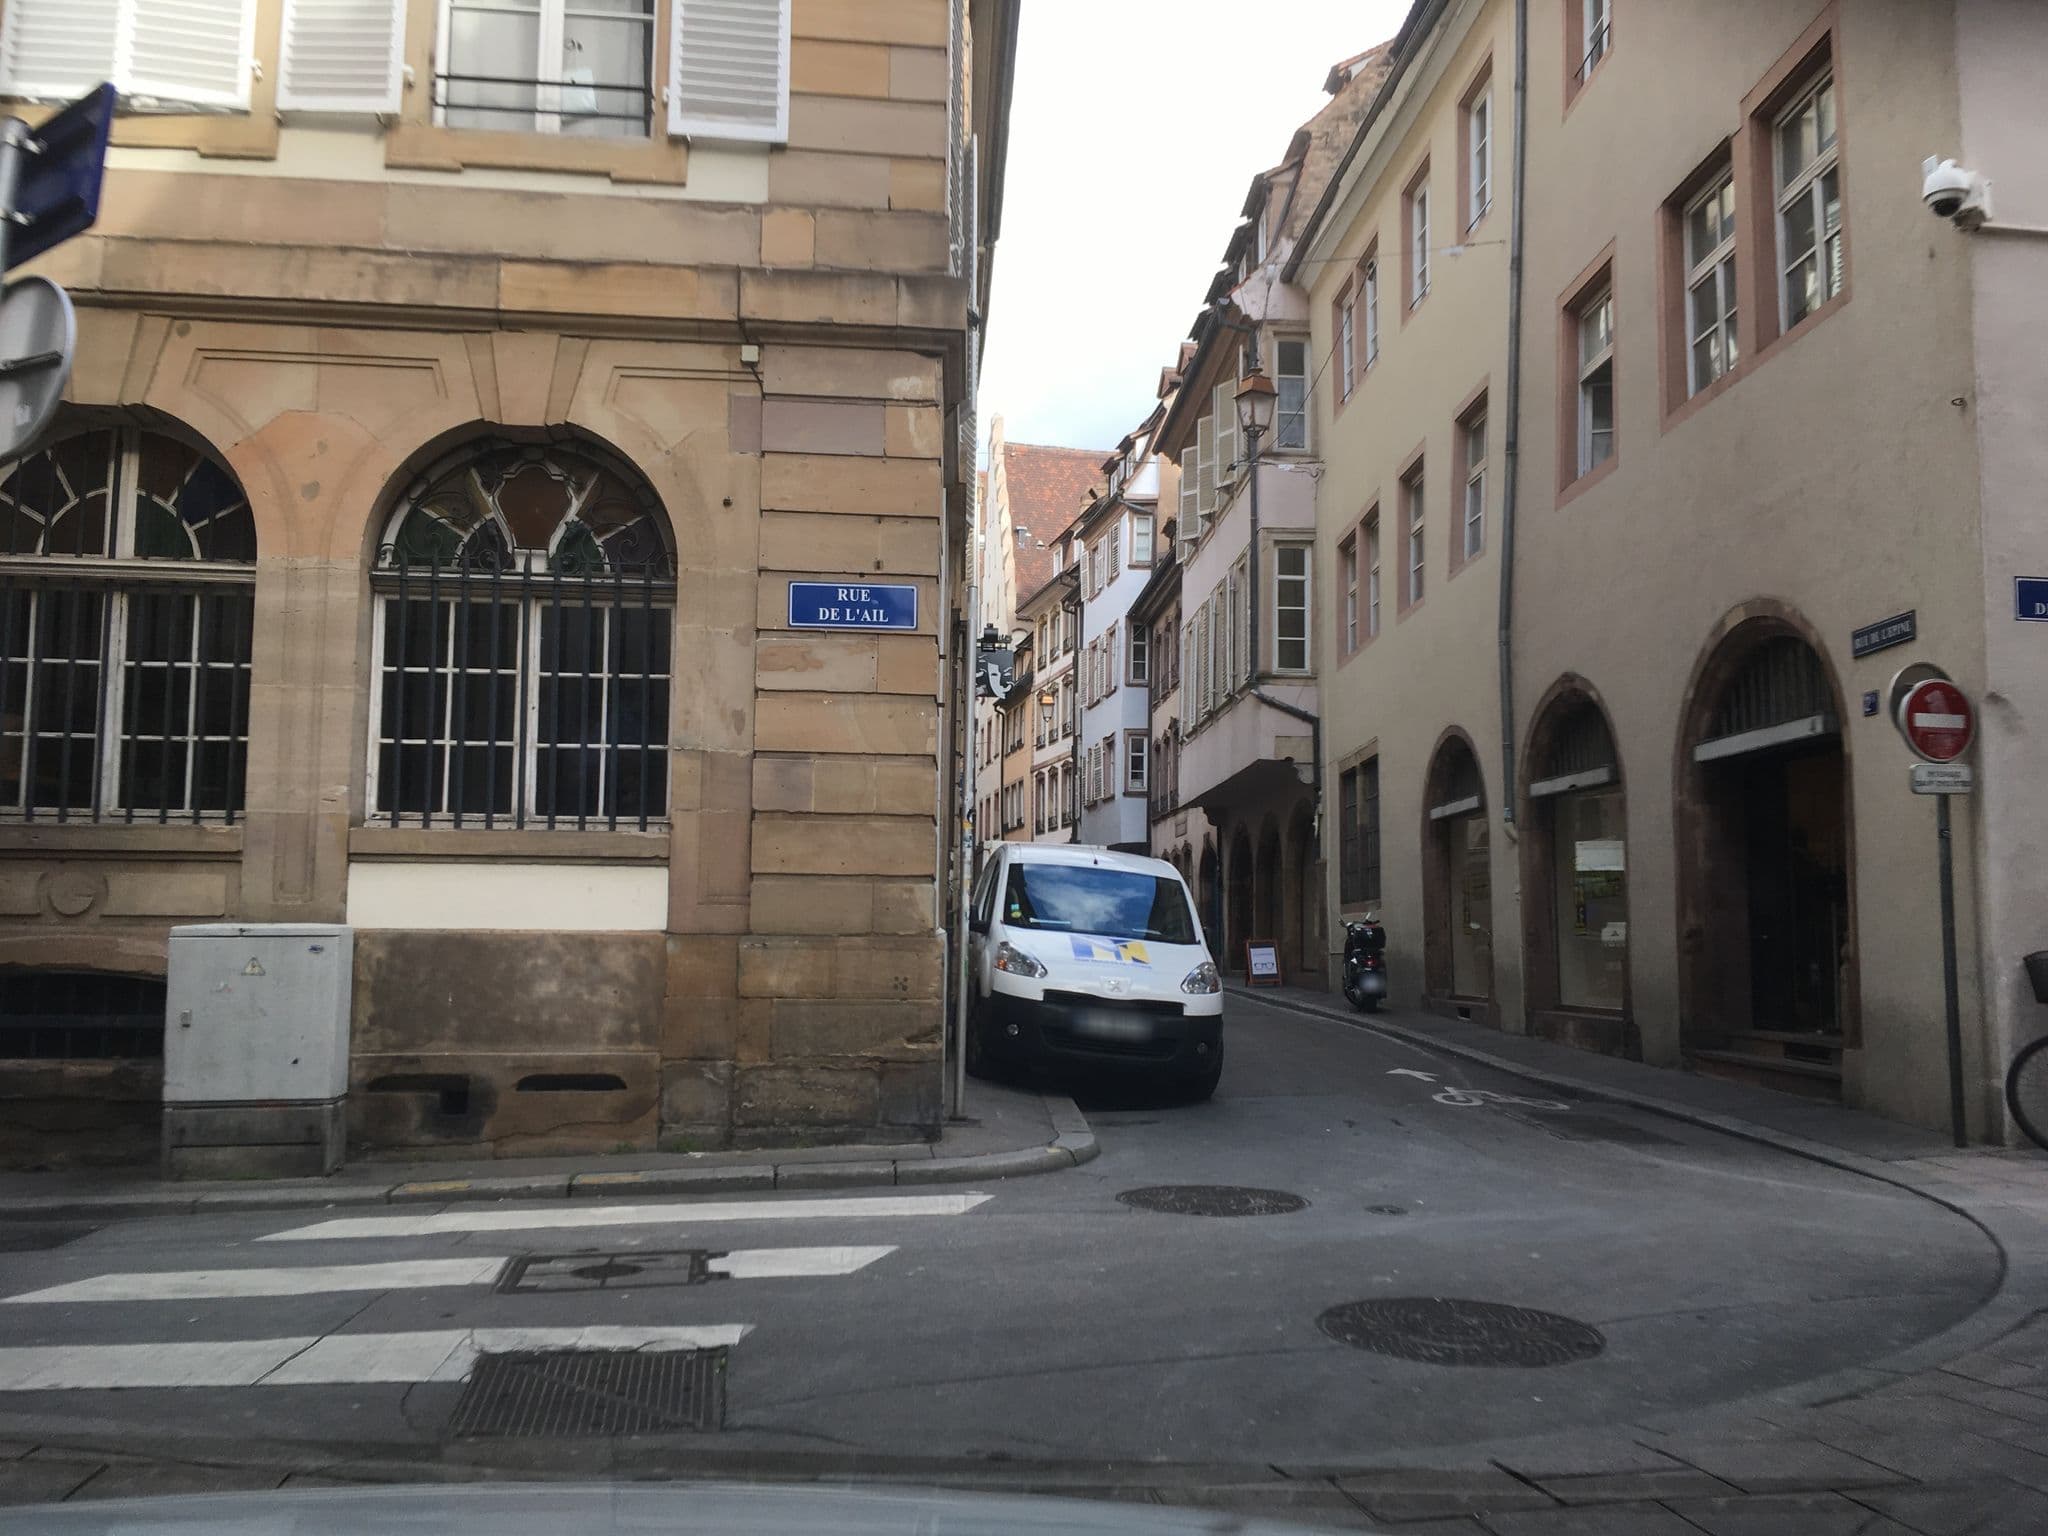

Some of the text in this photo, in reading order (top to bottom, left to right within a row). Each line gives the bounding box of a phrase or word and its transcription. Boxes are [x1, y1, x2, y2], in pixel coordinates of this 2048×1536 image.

[838, 588, 871, 602] RUE
[819, 607, 889, 623] DE L'AIL
[2034, 602, 2048, 615] D
